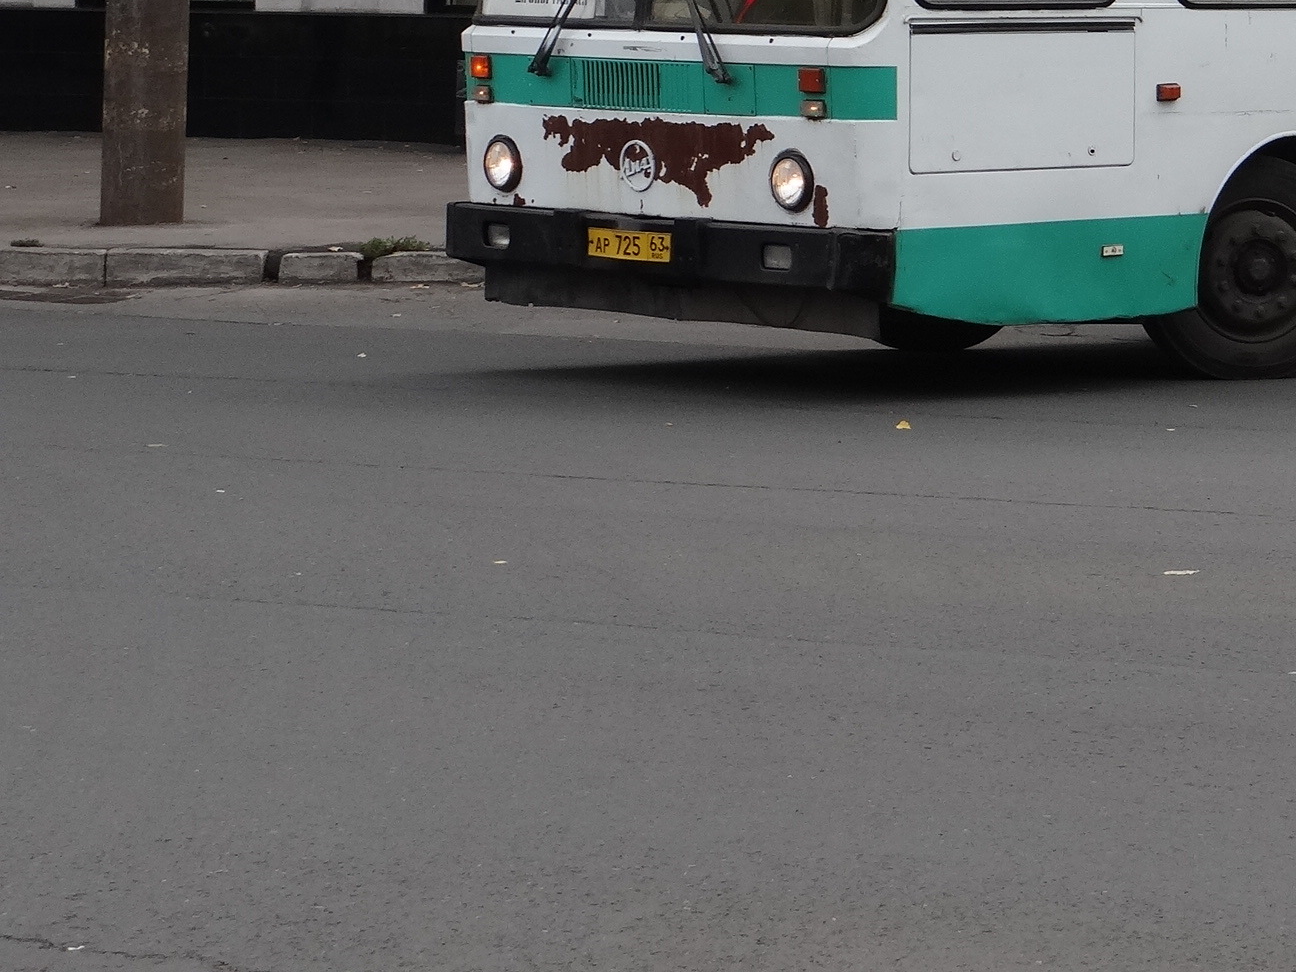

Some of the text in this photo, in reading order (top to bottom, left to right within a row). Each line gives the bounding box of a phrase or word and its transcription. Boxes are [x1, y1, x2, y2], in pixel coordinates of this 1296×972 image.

[595, 234, 665, 257] АР 725 63
